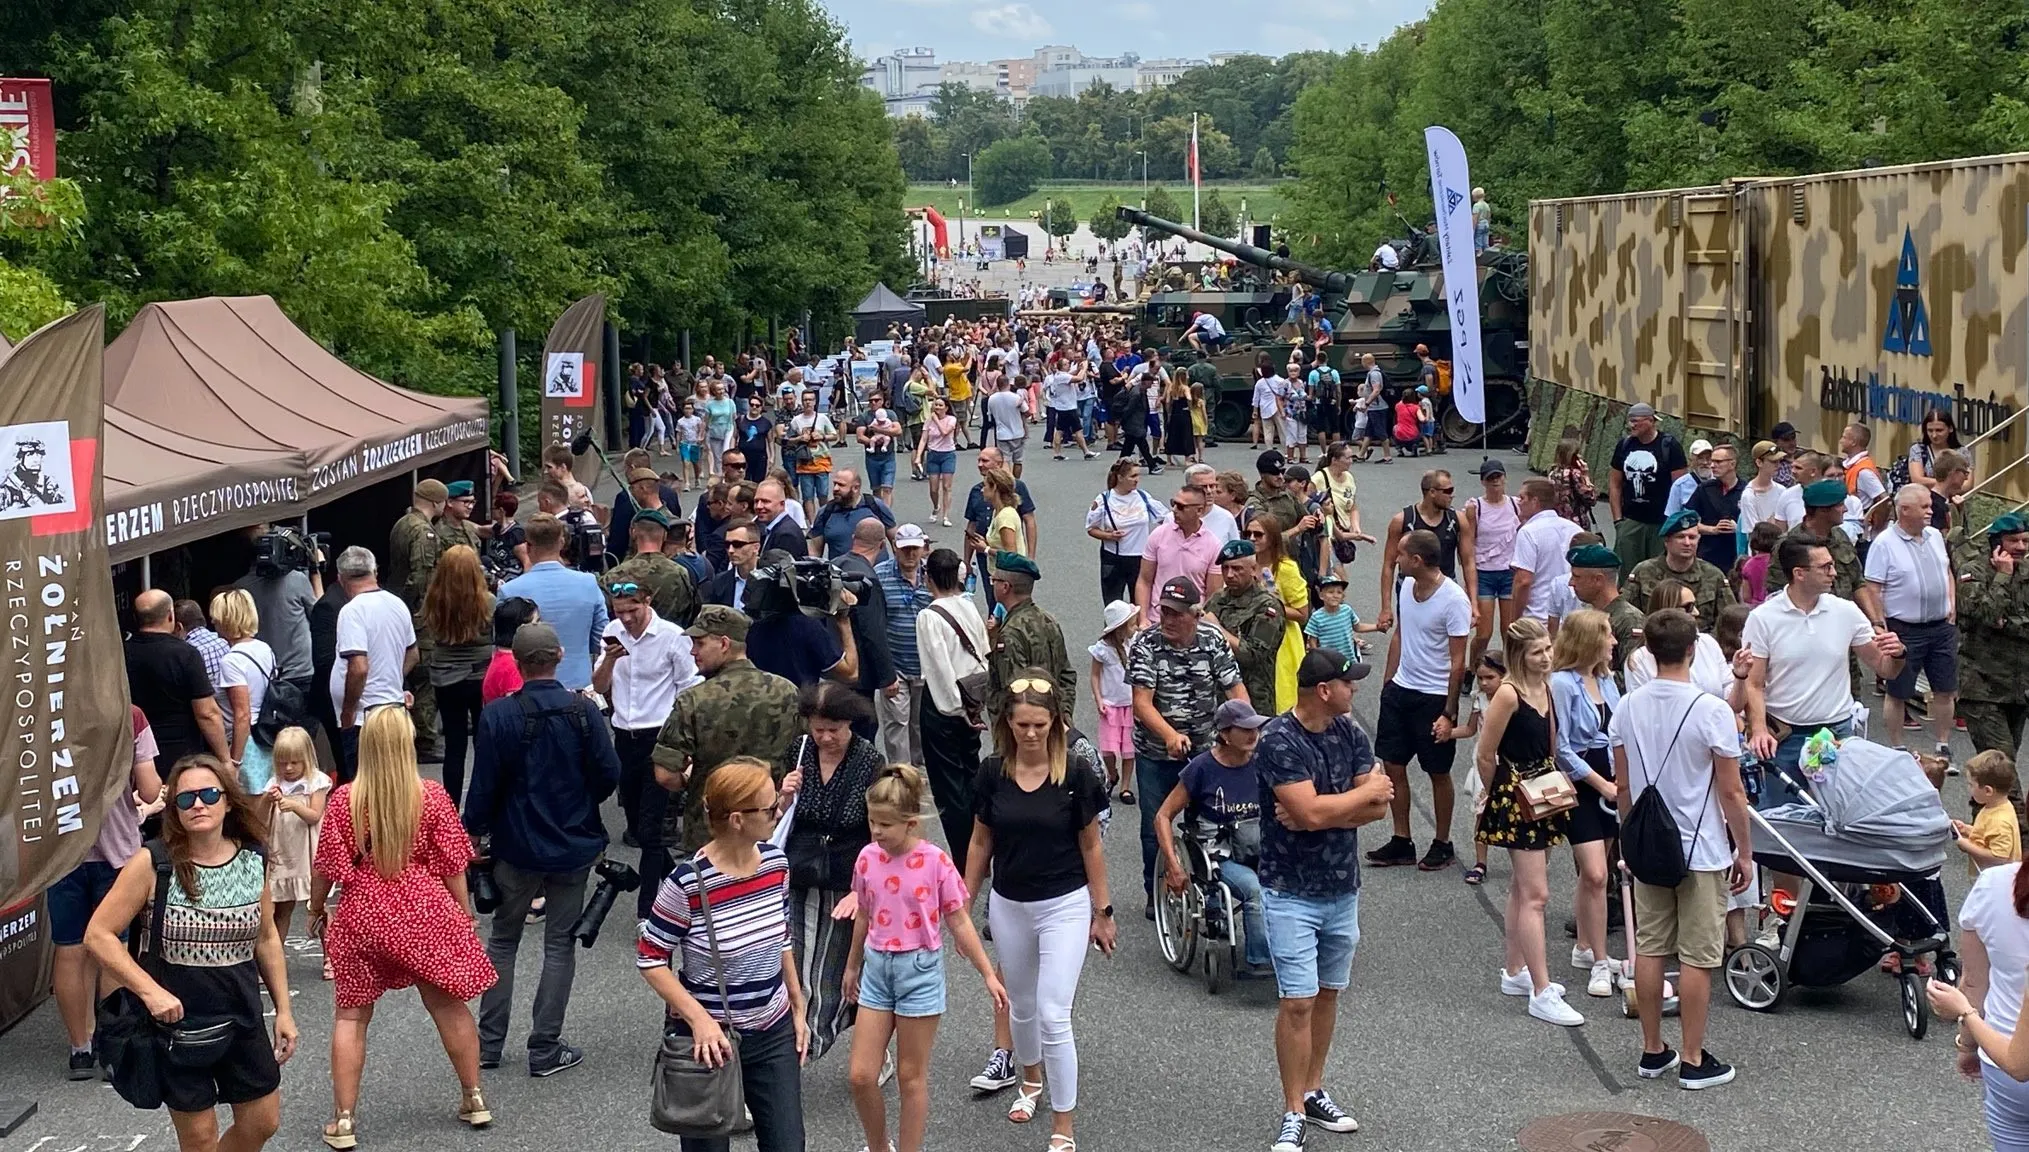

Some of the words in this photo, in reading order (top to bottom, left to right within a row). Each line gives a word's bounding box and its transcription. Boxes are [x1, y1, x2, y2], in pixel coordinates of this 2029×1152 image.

[106, 502, 164, 546] ERZEM
[173, 477, 299, 526] RZECZYPOSPOLITEJ
[312, 450, 358, 491] ZOSTAŃ
[363, 433, 423, 472] ŻOŁNIERZEM
[6, 560, 42, 842] RZECZYPOSPOLITEJ
[38, 554, 84, 836] ŻOŁNIERZEM
